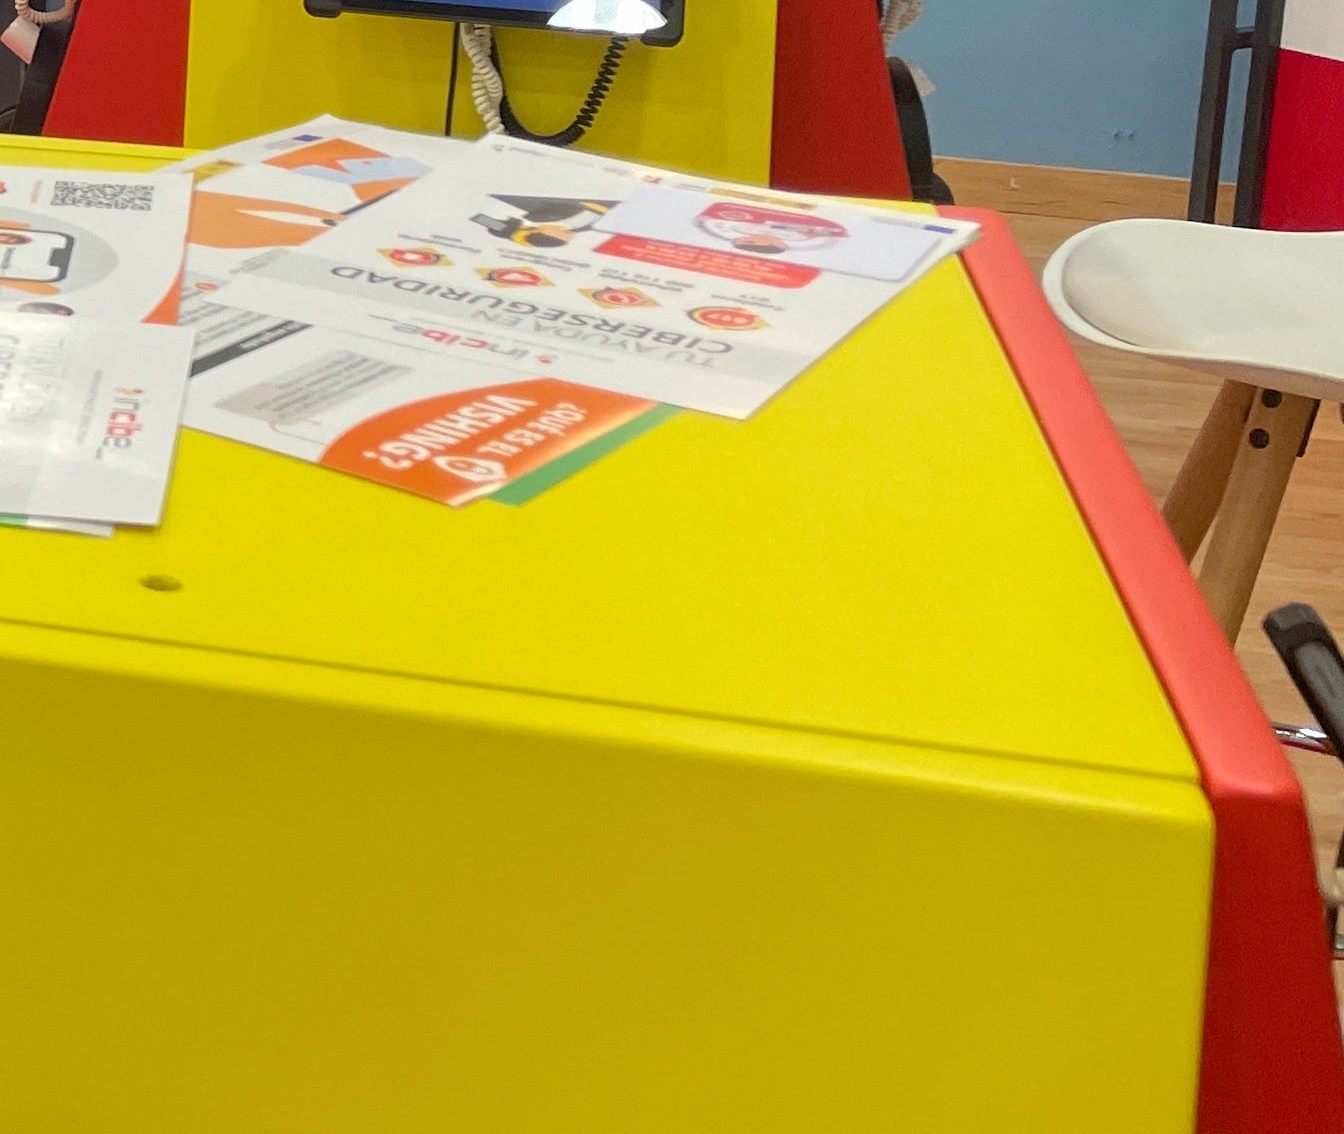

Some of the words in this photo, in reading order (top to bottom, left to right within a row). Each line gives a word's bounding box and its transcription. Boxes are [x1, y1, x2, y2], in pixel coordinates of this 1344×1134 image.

[330, 265, 734, 355] CIBERSEGURIDAD
[362, 394, 539, 470] VISHING?
[527, 402, 589, 436] ¿QUÉ
[475, 440, 523, 457] EL
[503, 428, 546, 447] ES
